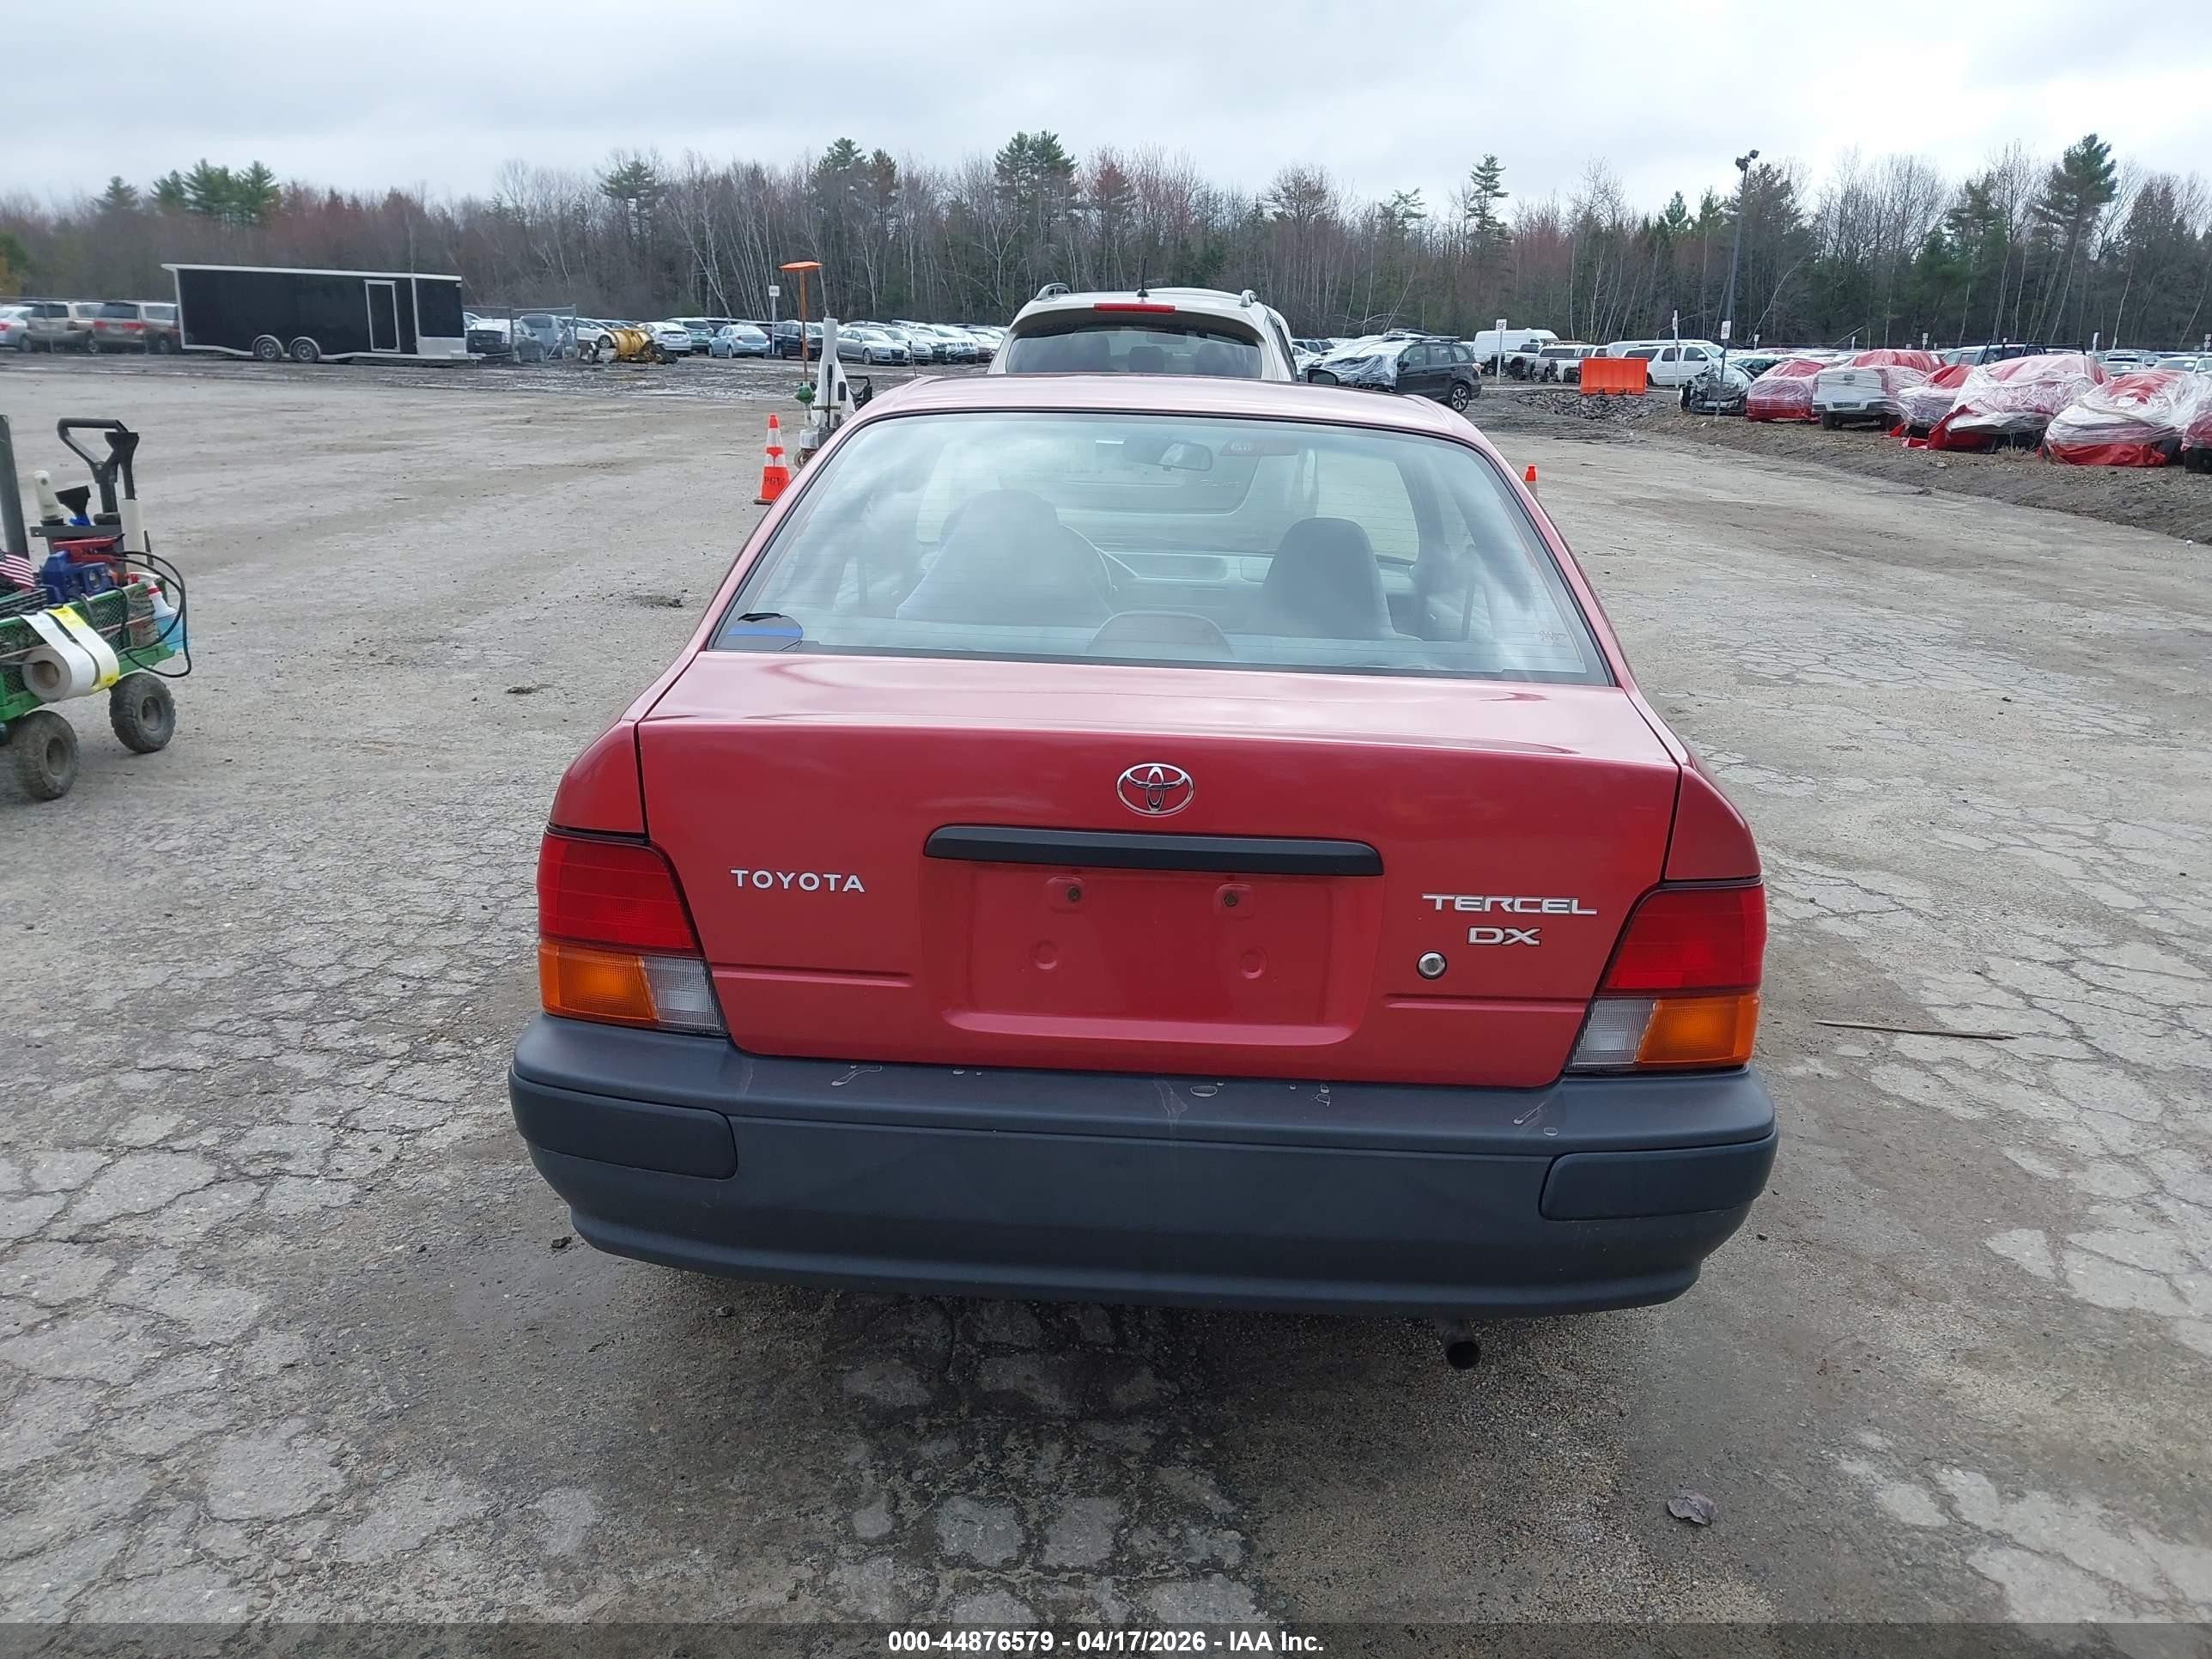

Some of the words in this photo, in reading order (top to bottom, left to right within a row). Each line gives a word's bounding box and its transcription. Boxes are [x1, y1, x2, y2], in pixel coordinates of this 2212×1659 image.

[730, 869, 866, 893] TOYOTA
[1421, 893, 1598, 915] TERCEL
[1468, 927, 1541, 945] DX
